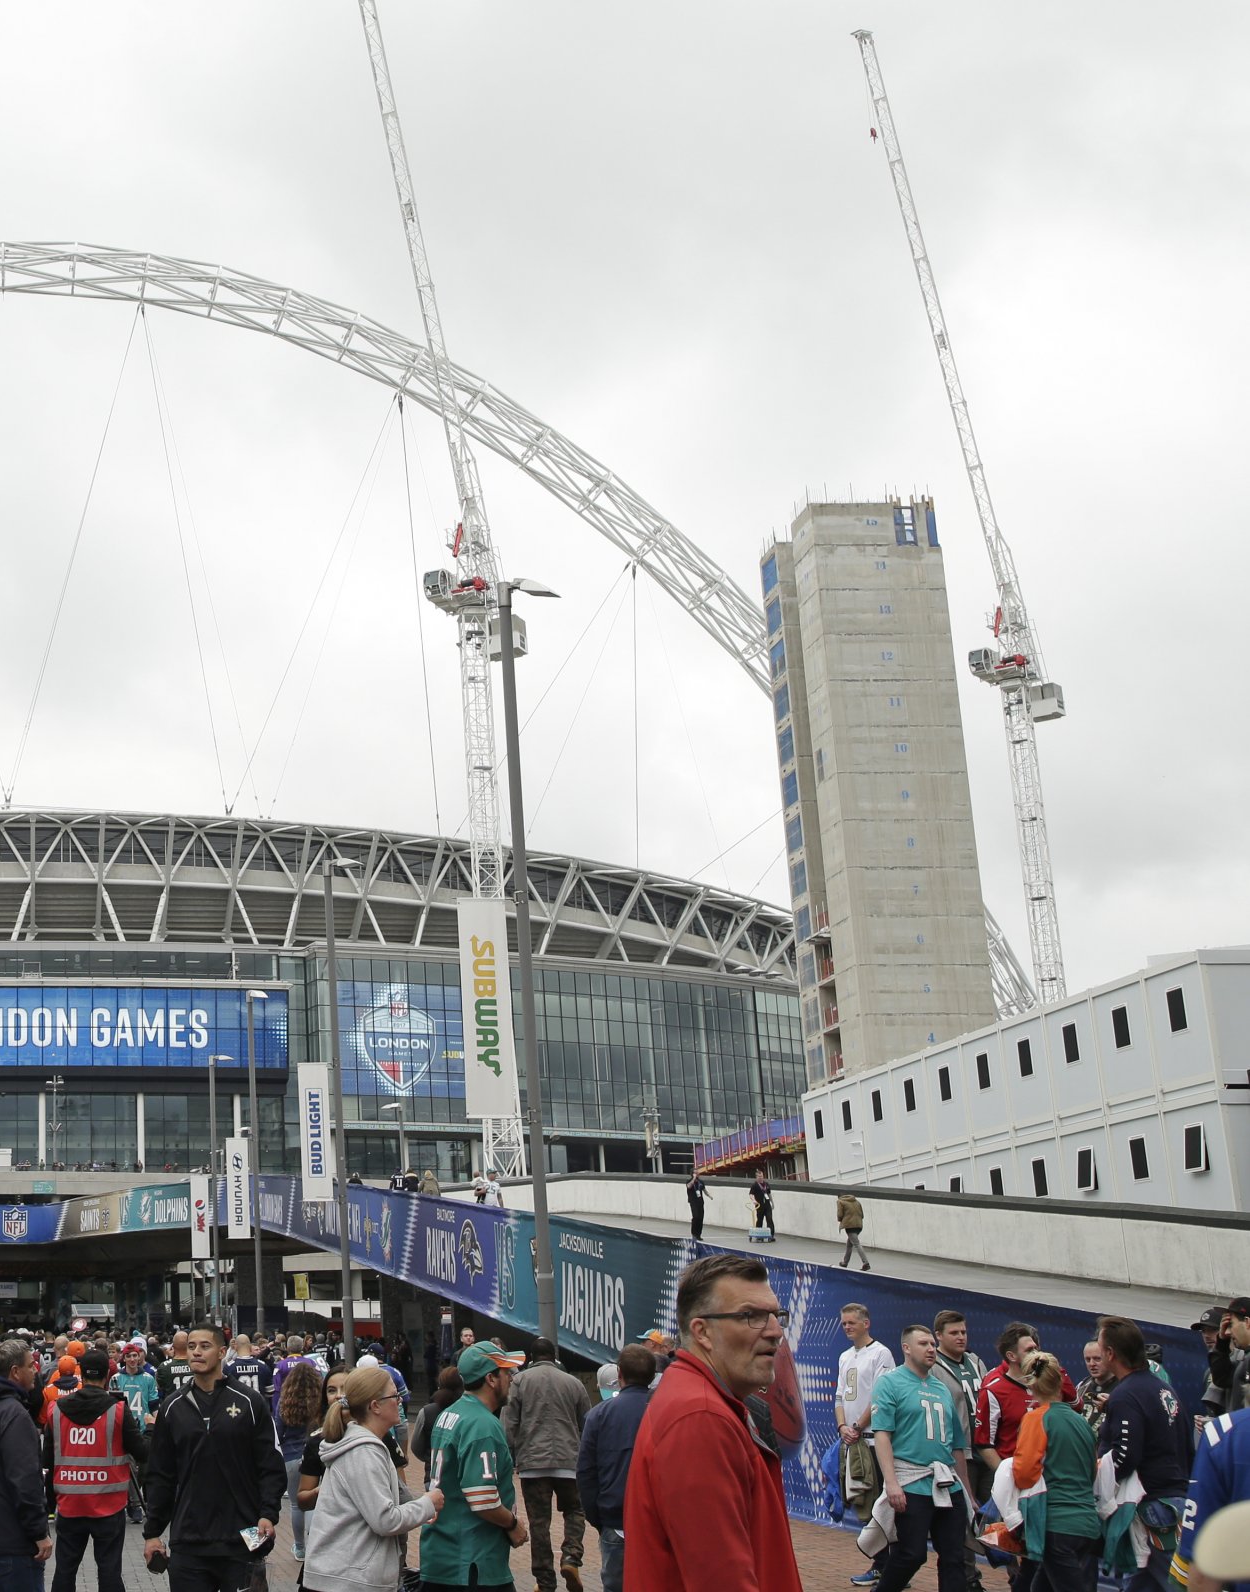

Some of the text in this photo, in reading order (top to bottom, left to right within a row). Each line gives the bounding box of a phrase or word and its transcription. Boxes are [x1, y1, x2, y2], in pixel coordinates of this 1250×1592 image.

[881, 651, 893, 660] 12
[889, 697, 901, 707] 11
[894, 743, 908, 753] 10
[923, 983, 931, 993] 5
[390, 1002, 407, 1018] NFL
[470, 934, 503, 1078] SUBWAY
[90, 1007, 209, 1048] GAMES
[369, 1037, 431, 1050] LONDON
[927, 1032, 936, 1043] 4
[308, 1091, 323, 1175] BUD LIGHT
[234, 1175, 244, 1226] HYUNDAI
[154, 1197, 188, 1224] DOLPHINS
[436, 1207, 455, 1223] BALTIMORE
[5, 1221, 25, 1235] NFL
[80, 1208, 100, 1232] SAINTS
[558, 1232, 604, 1259] JACKSONVILLE
[426, 1227, 456, 1285] RAVENS
[559, 1261, 625, 1351] JAGUARS
[236, 1365, 259, 1373] ELLIOTT
[845, 1368, 858, 1402] 9
[921, 1400, 947, 1443] 11
[69, 1427, 96, 1445] 020
[60, 1470, 108, 1482] PHOTO
